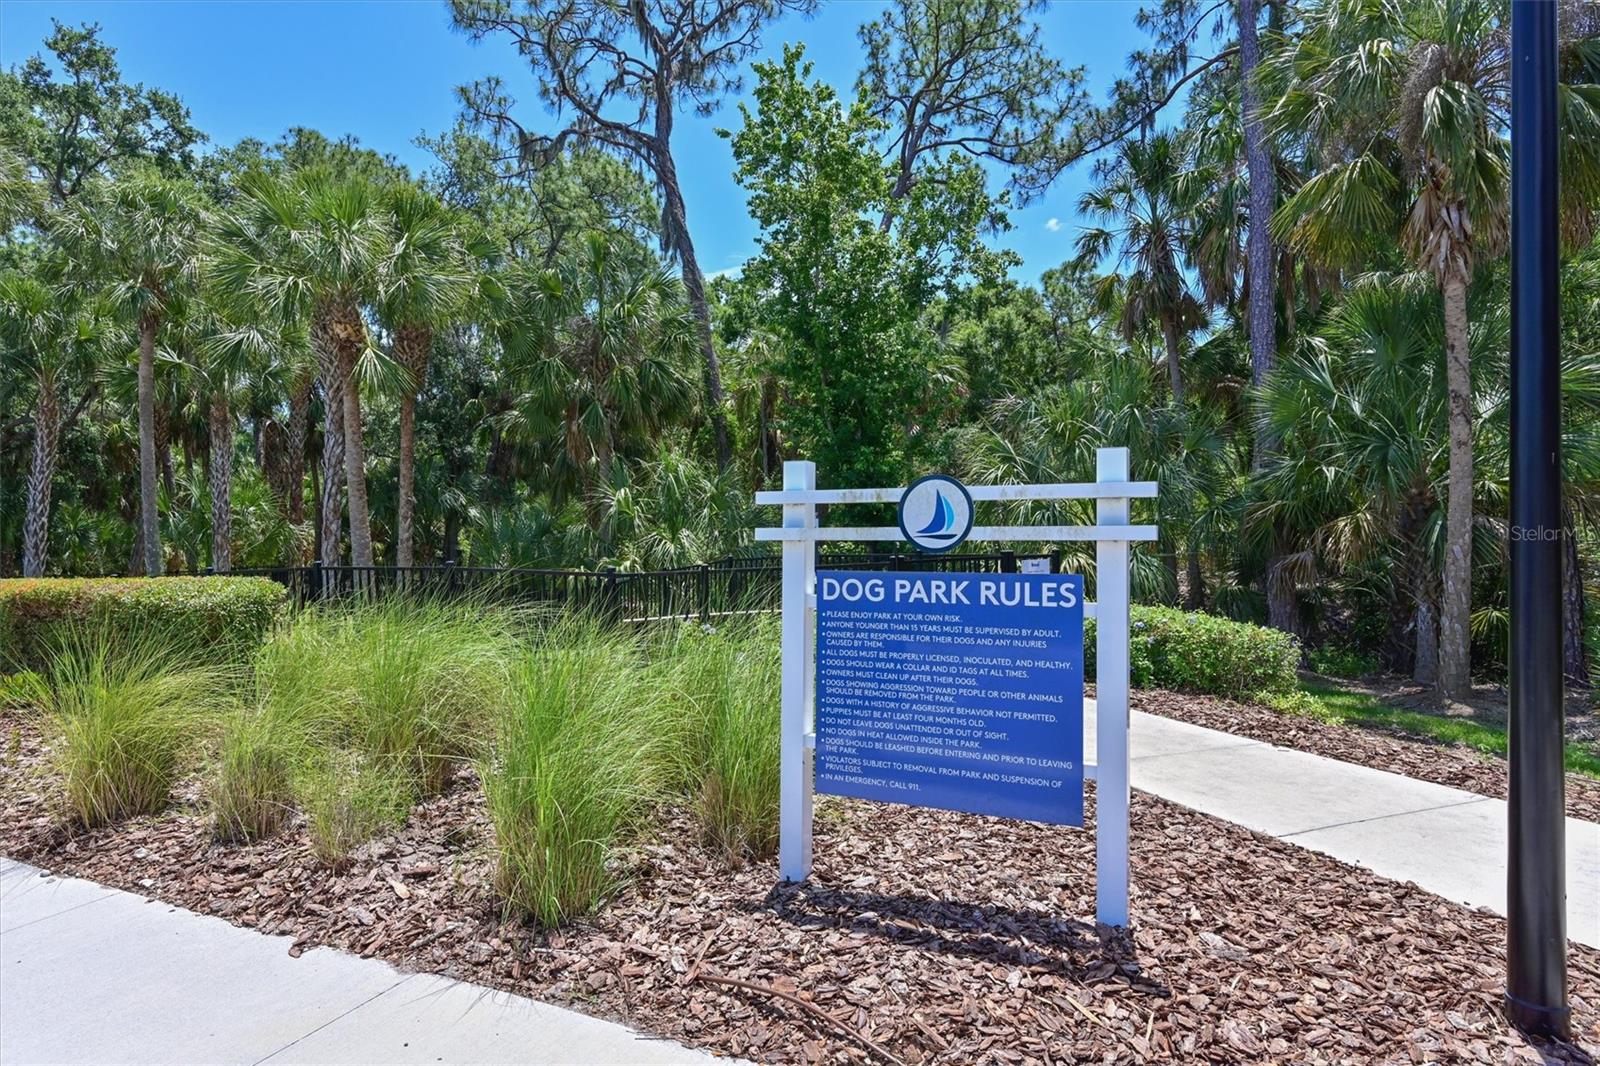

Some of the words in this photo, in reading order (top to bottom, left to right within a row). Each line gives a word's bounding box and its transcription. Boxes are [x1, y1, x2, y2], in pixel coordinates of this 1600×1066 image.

[823, 578, 884, 601] DOG
[895, 579, 970, 604] PARK
[980, 581, 1076, 607] RULES
[826, 610, 848, 618] PLEASE
[944, 614, 962, 622] RISK.
[826, 620, 853, 628] ANYONE
[855, 621, 888, 630] YOUNGER
[919, 624, 941, 632] YEARS
[942, 625, 962, 633] MUST
[975, 626, 1019, 635] SUPERVISED
[1021, 628, 1031, 636] BY
[1033, 629, 1060, 637] ADULT.
[826, 630, 854, 638] OWNERS
[870, 632, 914, 641] RESPONSIBLE
[916, 634, 930, 642] FOR
[932, 635, 952, 643] THEIR
[954, 636, 974, 644] DOGS
[976, 637, 993, 645] AND
[1012, 639, 1046, 648] INJURIES
[826, 638, 852, 646] CAUSED
[864, 640, 884, 648] THEM.
[826, 658, 844, 666] DOGS
[845, 659, 874, 668] SHOULD
[875, 661, 894, 669] WEAR
[902, 663, 930, 671] COLLAR
[958, 666, 977, 674] TAGS
[1005, 669, 1028, 678] TIMES.
[888, 651, 924, 660] PROPERLY
[925, 654, 961, 663] LICENSED,
[963, 656, 1013, 666] INOCULATED,
[1015, 659, 1033, 667] AND
[1034, 660, 1072, 669] HEALTHY.
[826, 668, 854, 677] OWNERS
[855, 670, 873, 678] MUST
[875, 672, 897, 680] CLEAN
[910, 674, 931, 682] AFTER
[933, 675, 953, 684] THEIR
[955, 677, 977, 685] DOGS.
[826, 678, 844, 687] DOGS
[845, 680, 878, 690] SHOWING
[880, 682, 924, 693] AGGRESSION
[925, 685, 957, 694] TOWARD
[958, 688, 985, 697] PEOPLE
[987, 690, 998, 698] OR
[1000, 691, 1025, 700] OTHER
[1028, 693, 1062, 702] ANIMALS
[826, 686, 853, 695] SHOULD
[854, 688, 862, 696] BE
[864, 689, 896, 698] REMOVED
[898, 691, 918, 700] FROM
[920, 693, 933, 701] THE
[935, 694, 956, 702] PARK.
[826, 696, 844, 704] DOGS
[870, 700, 899, 709] HISTORY
[900, 702, 910, 710] OF
[911, 703, 954, 713] AGGRESSIVE
[956, 706, 993, 717] BEHAVIOR
[995, 710, 1011, 718] NOT
[1013, 711, 1057, 722] PERMITTED.
[826, 706, 851, 715] PUPPIES
[853, 709, 871, 717] MUST
[873, 710, 881, 718] BE
[892, 712, 912, 720] LEAST
[914, 714, 933, 722] FOUR
[935, 716, 966, 725] MONTHS
[968, 718, 985, 727] OLD.
[826, 716, 836, 724] DO
[837, 717, 850, 725] NOT
[852, 719, 872, 727] LEAVE
[873, 720, 893, 729] DOGS
[894, 723, 941, 734] UNATTENDED
[943, 727, 954, 735] OR
[955, 728, 971, 736] OUT
[972, 730, 982, 738] OF
[984, 731, 1008, 740] SIGHT.
[837, 727, 856, 736] DOGS
[866, 730, 883, 739] HEAT
[885, 732, 918, 742] ALLOWED
[920, 736, 943, 744] INSIDE
[944, 738, 958, 746] THE
[960, 740, 981, 748] PARK.
[825, 744, 837, 752] THE
[839, 746, 858, 754] PARK.
[825, 736, 844, 746] DOGS
[845, 738, 873, 749] SHOULD
[884, 742, 915, 752] LEASHED
[916, 746, 942, 755] BEFORE
[944, 748, 980, 759] ENTERING
[982, 752, 999, 761] AND
[1001, 754, 1024, 764] PRIOR
[1026, 757, 1037, 765] TO
[1038, 758, 1072, 769] LEAVING
[825, 762, 862, 773] PRIVILEGES.
[825, 754, 861, 766] VIOLATORS
[862, 758, 890, 768] SUBJECT
[892, 762, 902, 770] TO
[903, 763, 936, 774] REMOVAL
[938, 767, 959, 776] FROM
[961, 770, 980, 778] PARK
[982, 772, 999, 781] AND
[1001, 774, 1049, 786] SUSPENSION
[1051, 780, 1062, 788] OF
[845, 775, 887, 787] EMERGENCY,
[889, 780, 906, 789] CALL
[908, 782, 920, 790] 911.
